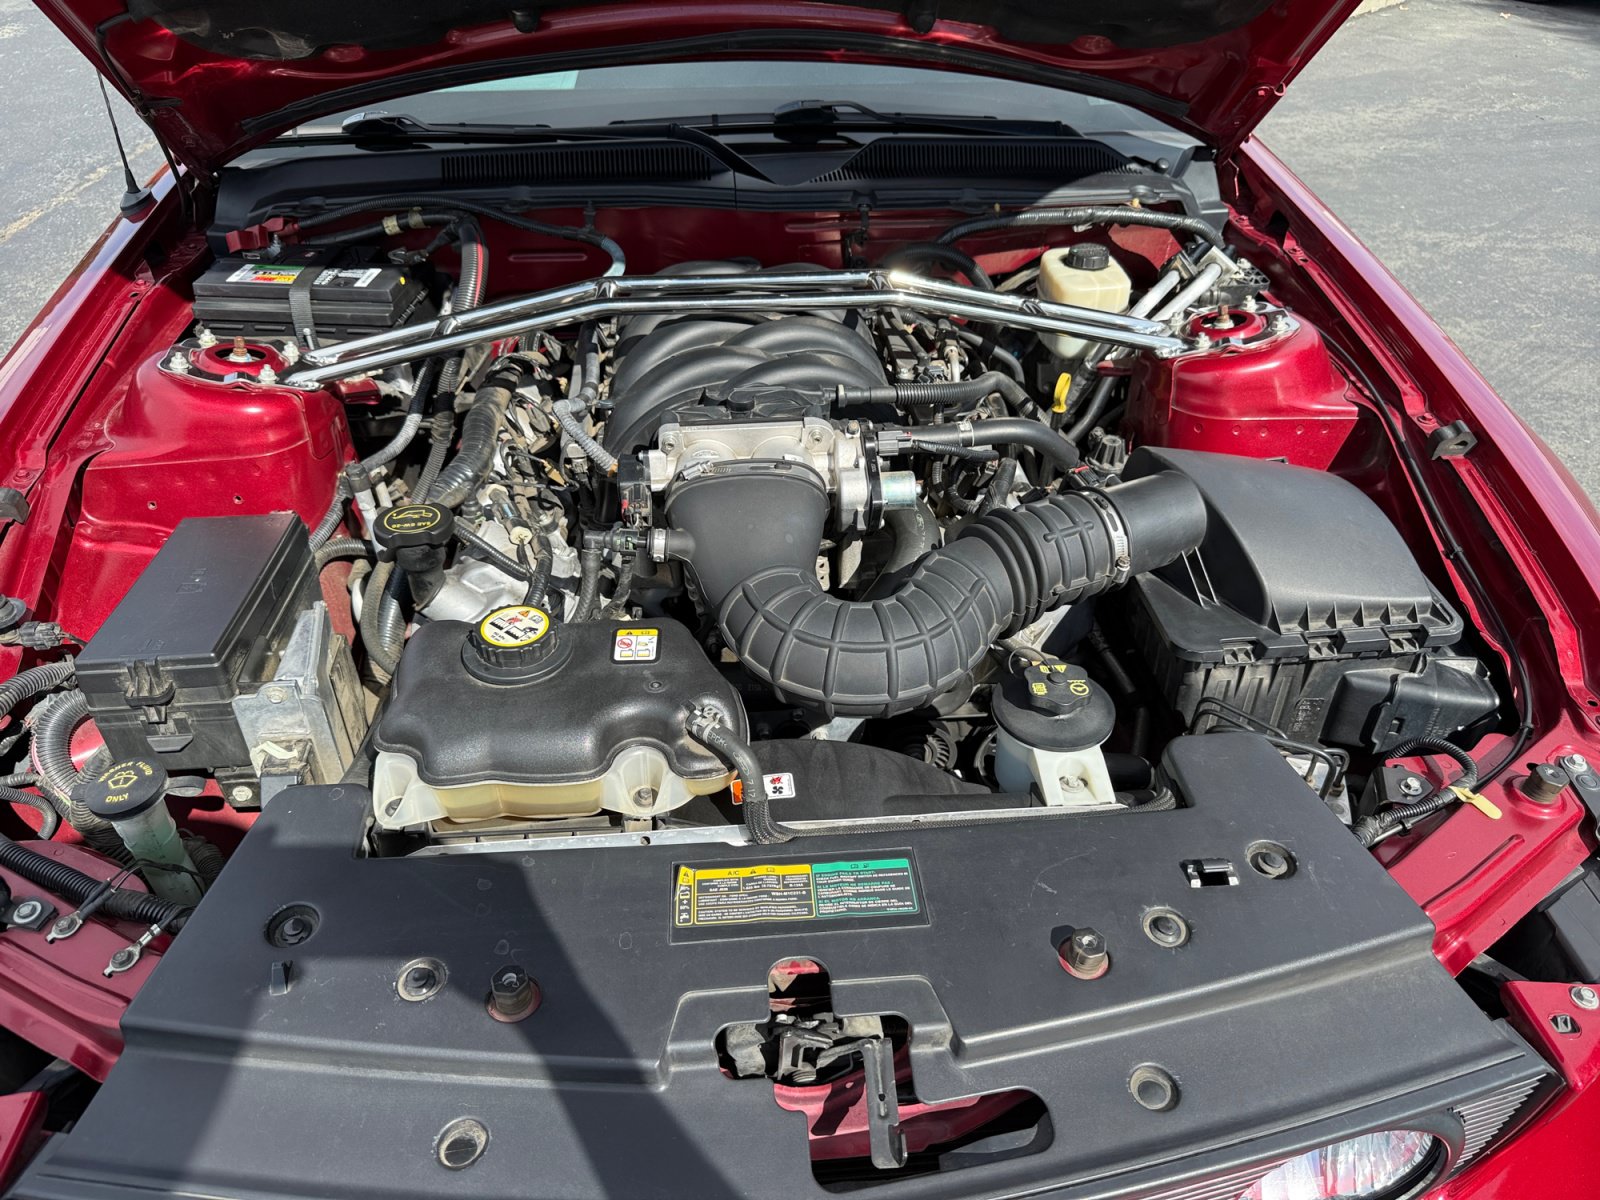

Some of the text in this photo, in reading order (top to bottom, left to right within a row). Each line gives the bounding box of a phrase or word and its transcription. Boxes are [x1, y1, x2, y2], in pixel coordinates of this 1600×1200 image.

[97, 761, 153, 783] WASHER FLUID
[105, 792, 129, 803] ONLY
